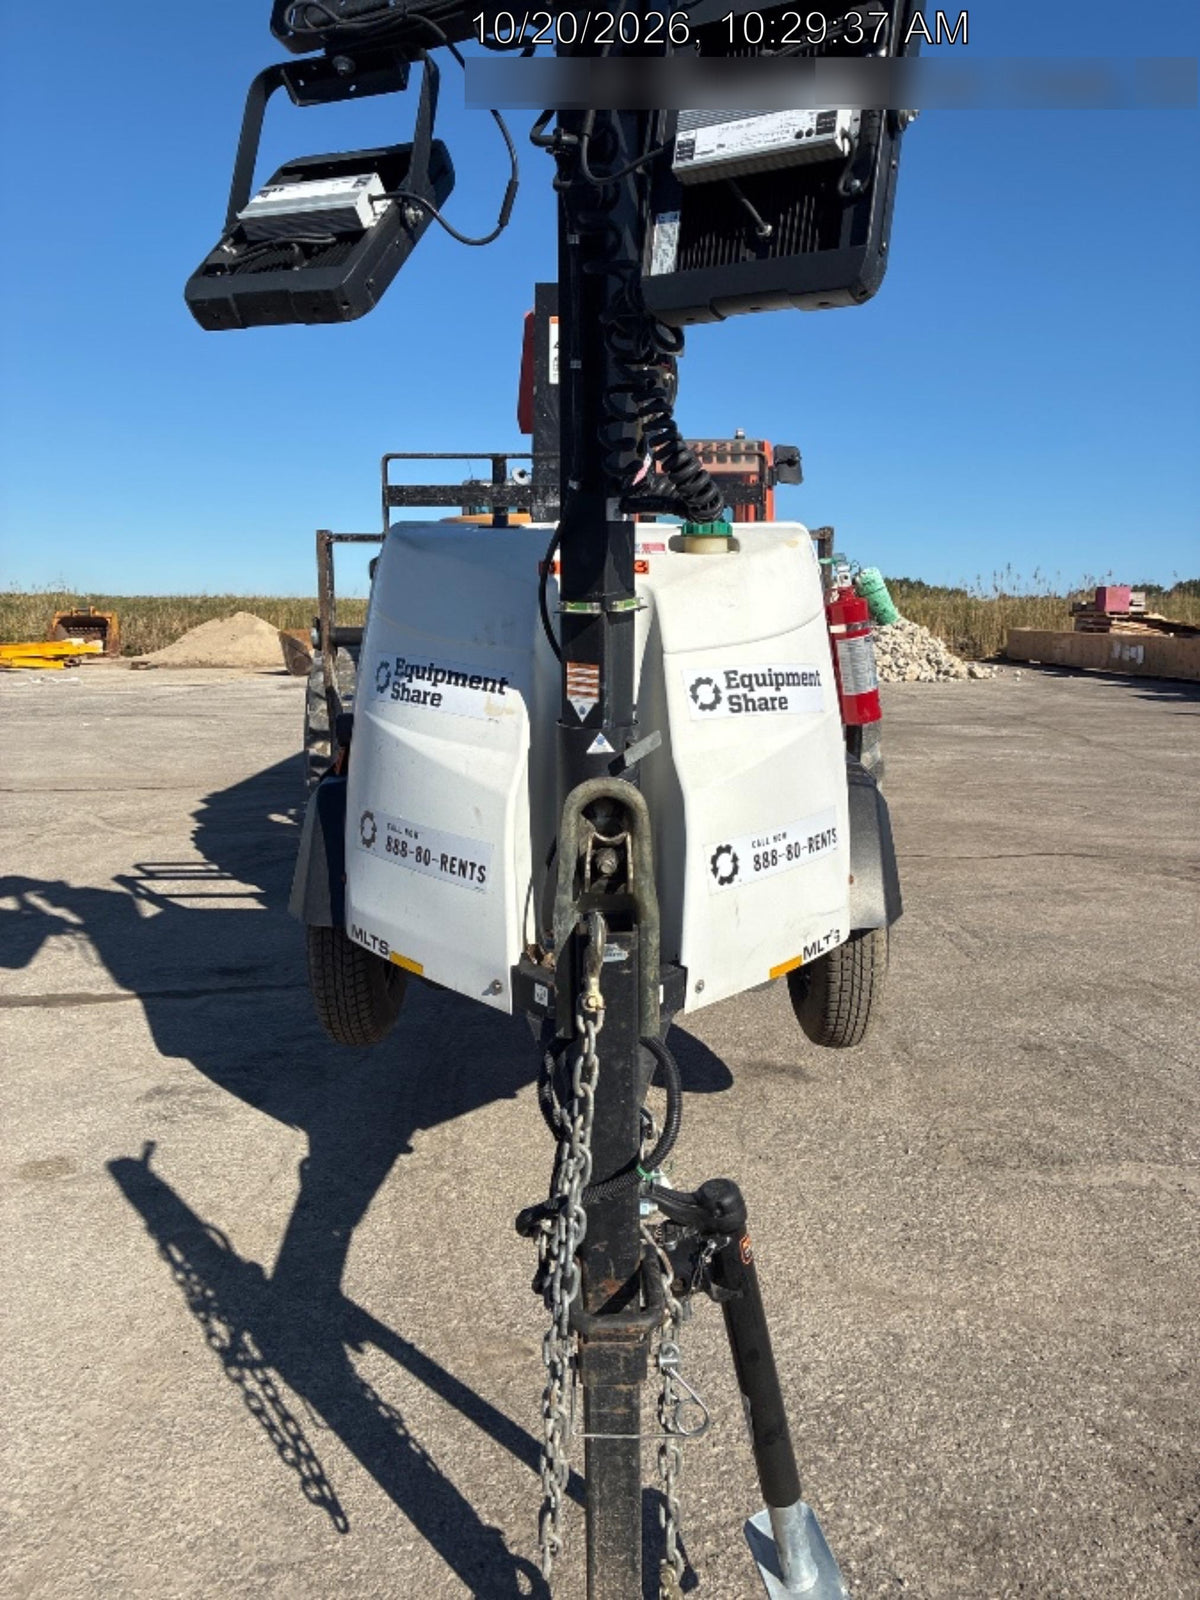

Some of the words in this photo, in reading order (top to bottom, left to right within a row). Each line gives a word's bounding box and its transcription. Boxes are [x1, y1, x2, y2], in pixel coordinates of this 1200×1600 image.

[394, 657, 509, 695] Equipment
[723, 668, 822, 692] Equipment
[390, 680, 442, 707] Share
[727, 693, 788, 713] Share
[385, 835, 487, 883] 888-80-RENTS
[753, 827, 837, 872] 888-80-RENTS
